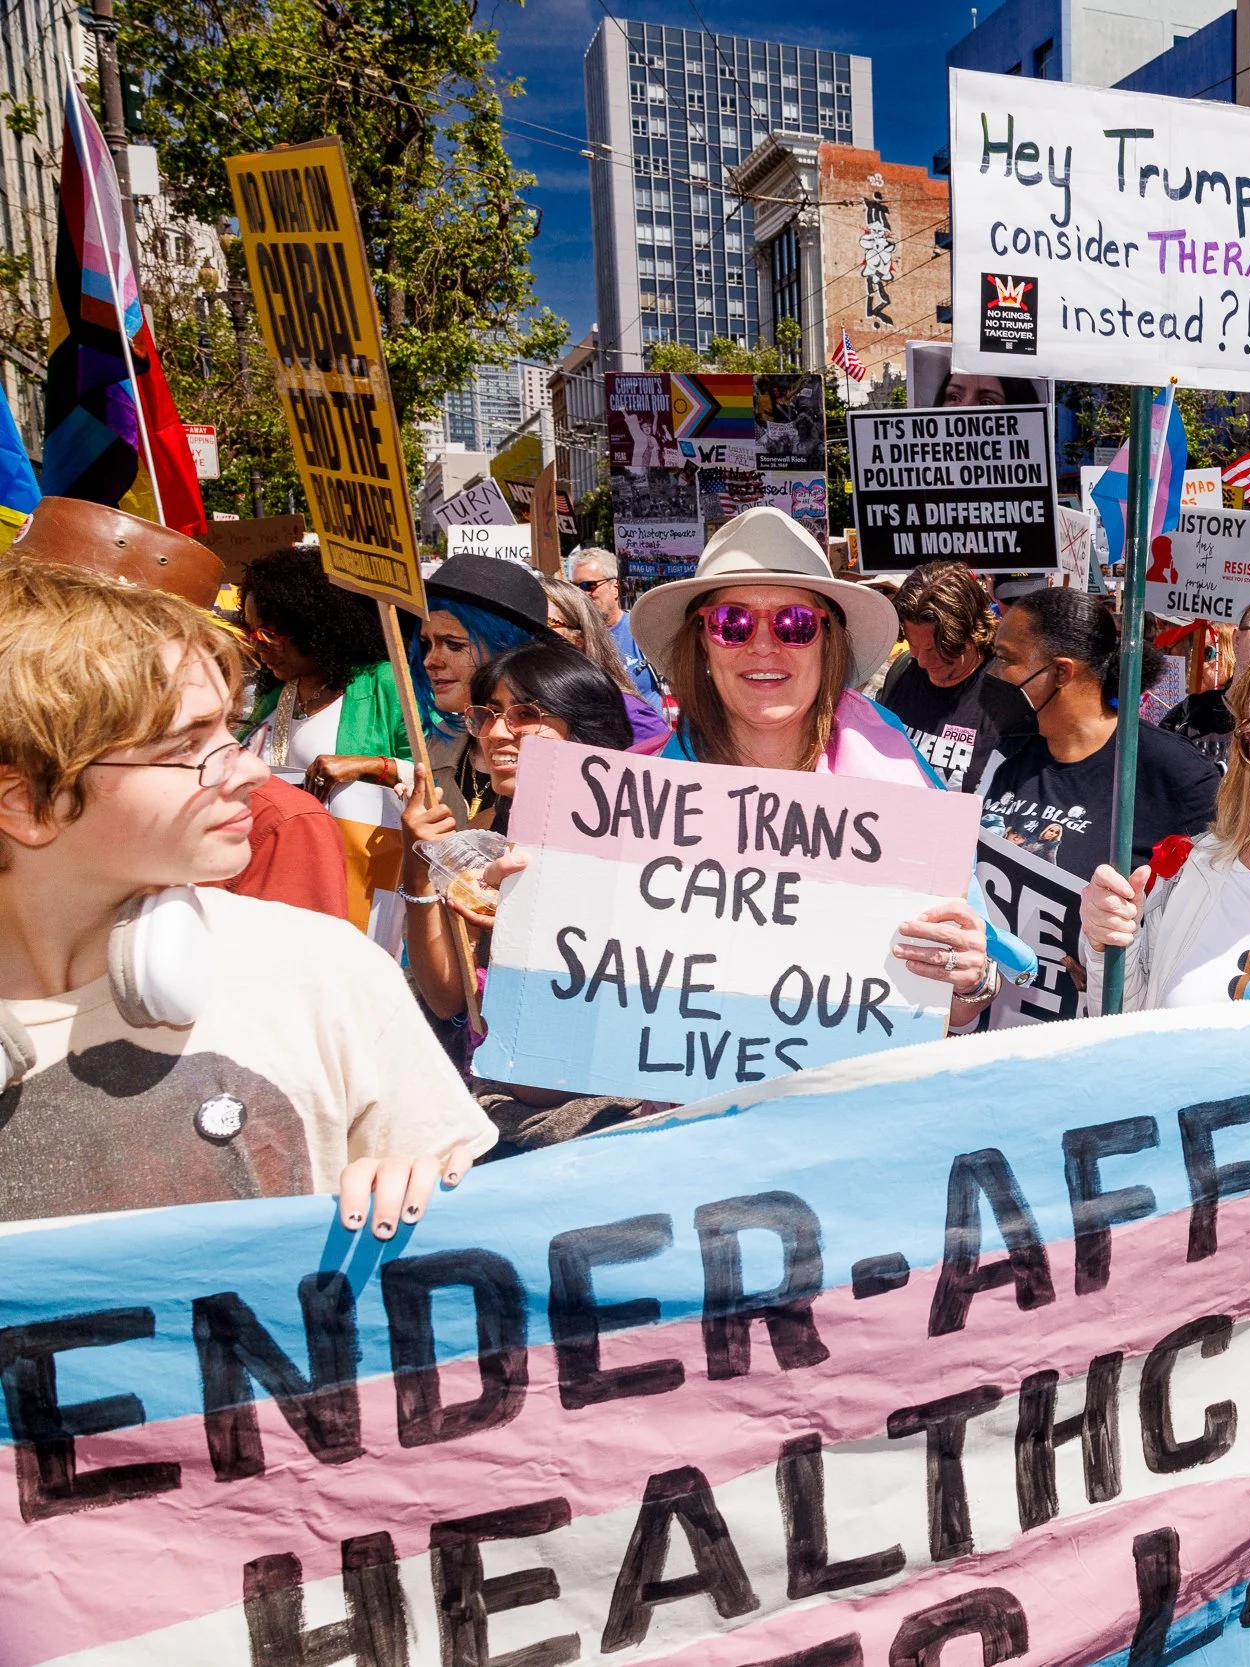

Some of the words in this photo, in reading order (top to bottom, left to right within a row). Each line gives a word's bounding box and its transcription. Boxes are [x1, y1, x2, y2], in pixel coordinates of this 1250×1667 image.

[980, 112, 1072, 227] Hey
[237, 172, 266, 233] NO
[261, 169, 312, 232] WAR
[305, 166, 340, 232] ON
[991, 220, 1138, 268] consider
[256, 243, 370, 376] CUBA!
[987, 310, 1001, 318] NO
[1002, 311, 1032, 320] KINGS.
[984, 329, 1034, 340] TAKEOVER.
[985, 320, 1000, 328] NO
[1000, 321, 1034, 330] TRUMP
[615, 377, 662, 395] COMPTON'S
[610, 394, 650, 412] CAFETERIA
[652, 394, 670, 412] RIOT
[289, 388, 343, 471] END
[331, 391, 391, 480] THE
[874, 419, 906, 440] IT'S
[912, 418, 938, 439] NO
[945, 416, 1018, 438] LONGER
[698, 444, 728, 464] WE
[872, 444, 884, 464] A
[890, 441, 1002, 464] DIFFERENCE
[1009, 440, 1030, 460] IN
[864, 466, 954, 488] POLITICAL
[960, 464, 1042, 486] OPINION
[1186, 480, 1215, 496] MAD
[310, 472, 404, 553] BLOCKADE!
[436, 481, 502, 524] TURN
[866, 504, 900, 527] IT'S
[906, 503, 920, 526] A
[926, 501, 1045, 525] DIFFERENCE
[462, 530, 489, 542] NO
[618, 526, 638, 538] Our
[638, 528, 670, 541] history
[894, 532, 915, 554] IN
[921, 531, 1022, 554] MORALITY.
[495, 546, 530, 560] KING
[1185, 578, 1218, 595] forgive
[1167, 591, 1233, 618] SILENCE
[904, 724, 974, 772] UEER
[944, 731, 974, 744] PRIDE
[571, 754, 703, 847] SAVE
[728, 785, 882, 862] TRANS
[1022, 802, 1038, 816] J.
[639, 856, 801, 926] CARE
[551, 926, 721, 1021] SAVE
[770, 964, 894, 1036] OUR
[638, 1027, 808, 1082] LIVES
